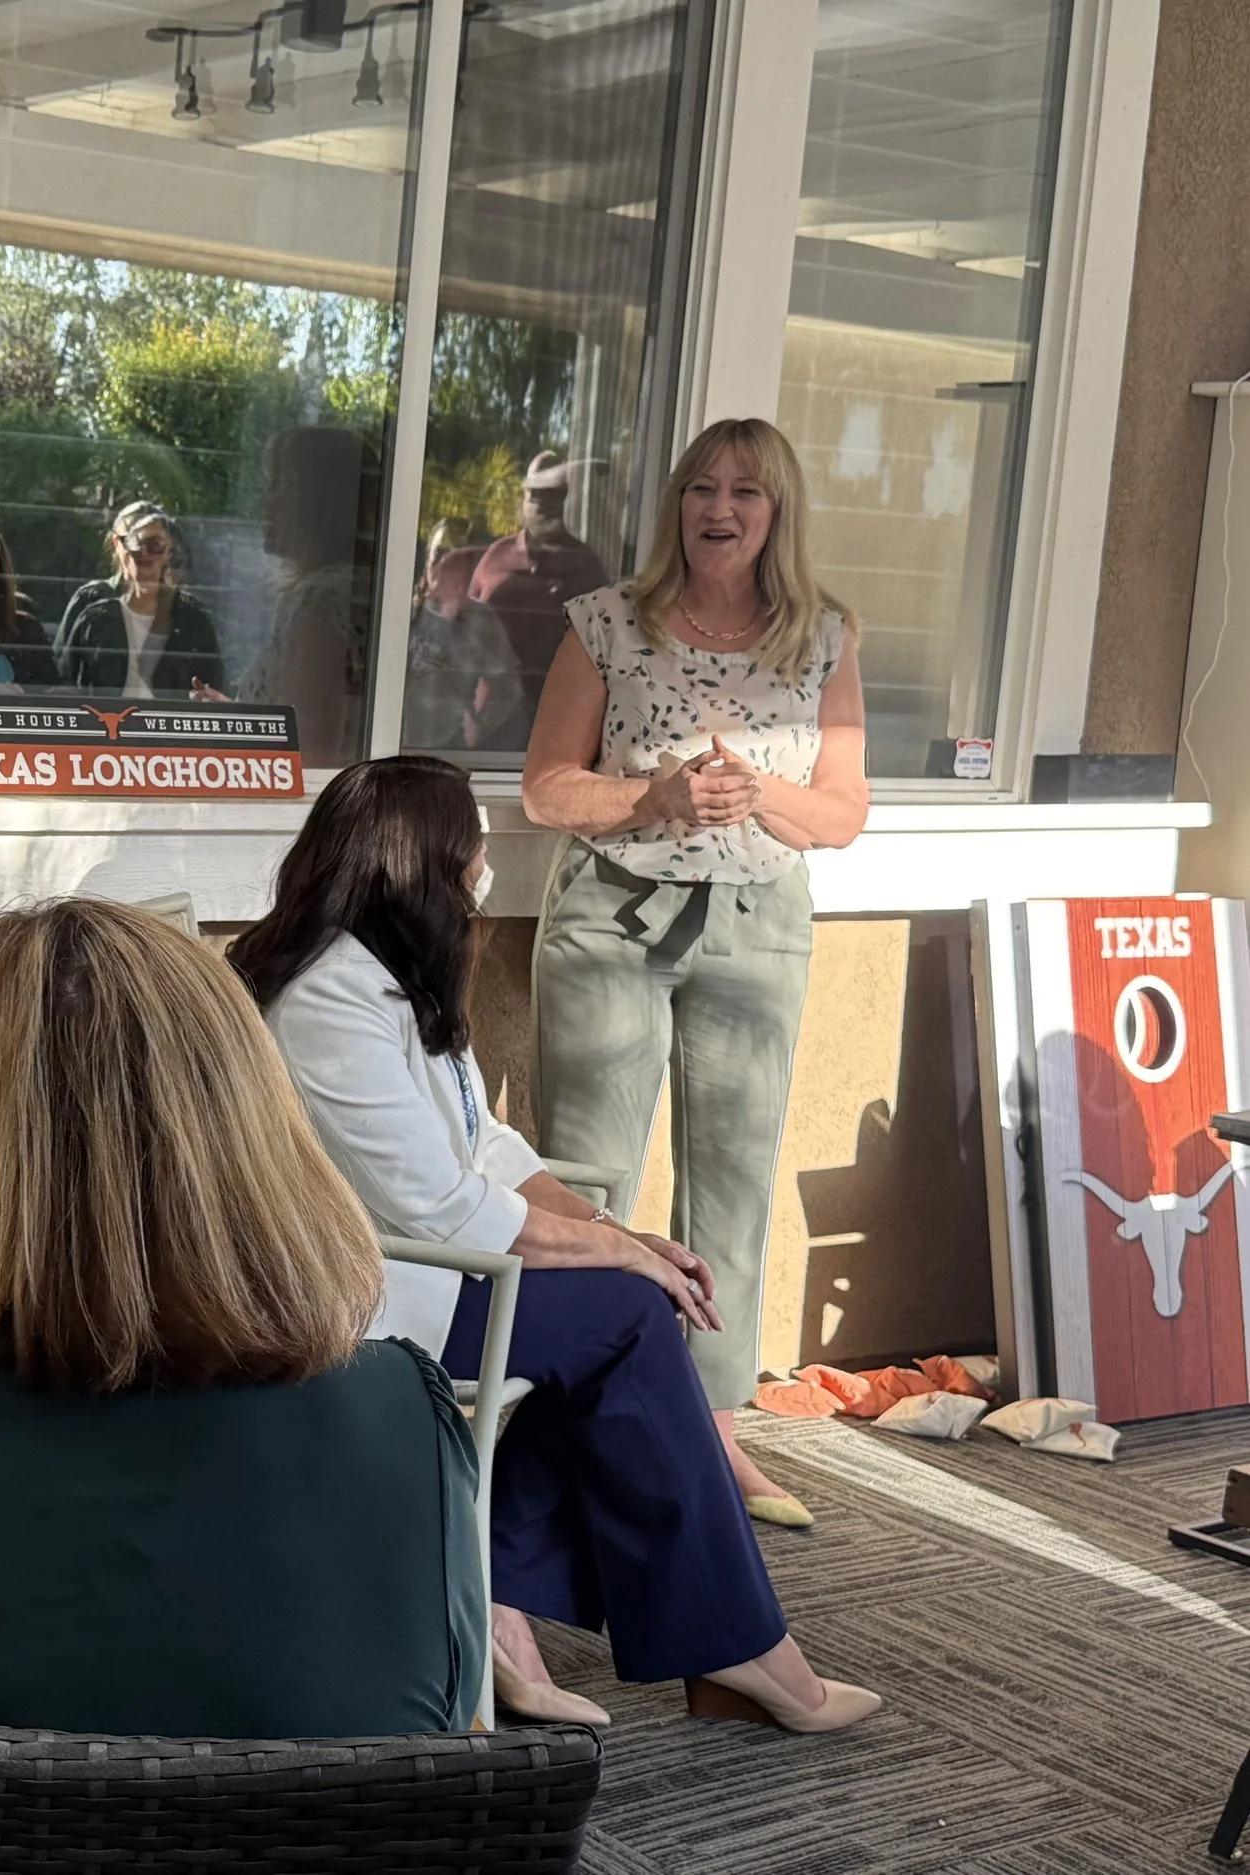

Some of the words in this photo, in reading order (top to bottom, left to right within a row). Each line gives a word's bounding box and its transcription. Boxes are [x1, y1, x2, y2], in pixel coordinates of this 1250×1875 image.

[15, 714, 78, 728] HOUSE
[144, 718, 167, 730] WE
[173, 719, 221, 732] CHEER
[226, 720, 254, 733] FOR
[258, 722, 287, 734] THE
[69, 753, 294, 791] LONGHORNS
[1093, 916, 1192, 959] TEXAS
